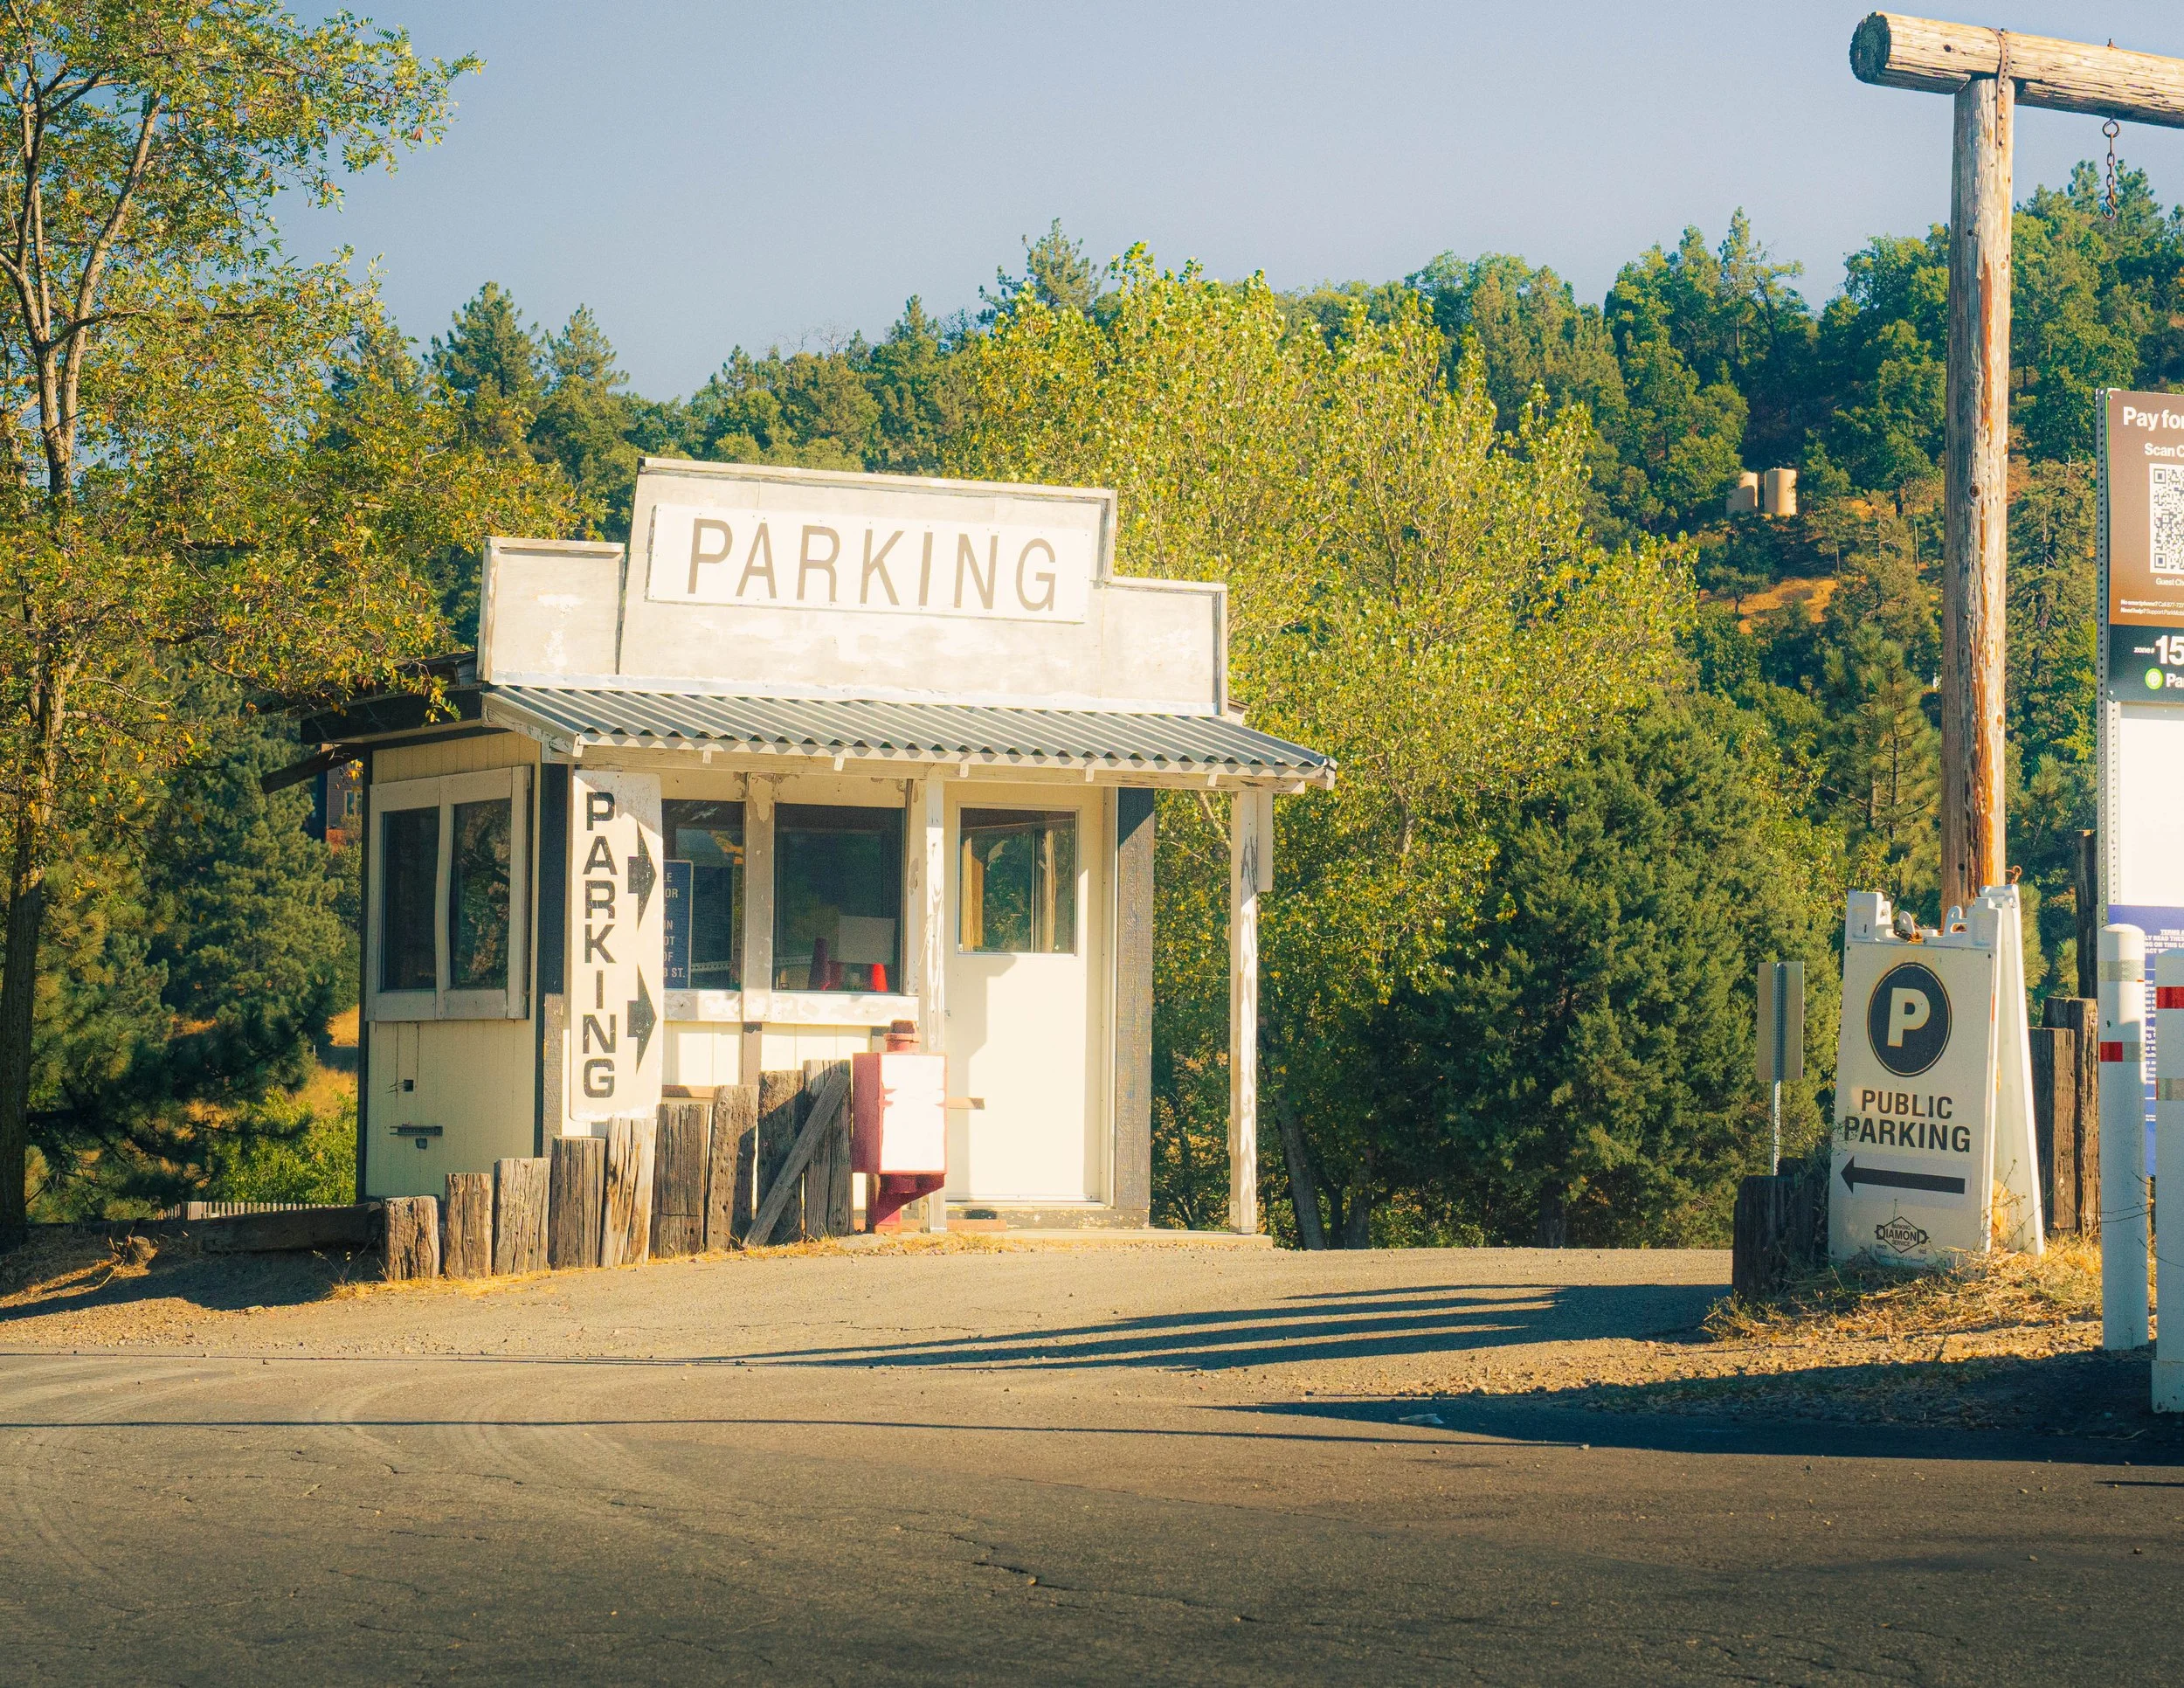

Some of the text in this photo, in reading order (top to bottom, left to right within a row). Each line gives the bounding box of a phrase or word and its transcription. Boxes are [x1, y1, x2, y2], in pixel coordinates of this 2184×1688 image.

[2123, 406, 2160, 432] Pay
[2144, 443, 2175, 457] Scan
[688, 517, 1056, 612] PARKING
[2155, 578, 2174, 586] Guest
[583, 791, 618, 1099] PARKING
[671, 967, 686, 978] ST.
[1887, 987, 1931, 1048] P
[1861, 1090, 1953, 1120] PUBLIC
[1844, 1115, 1971, 1153] PARKING
[1876, 1224, 1928, 1245] DIAMOND
